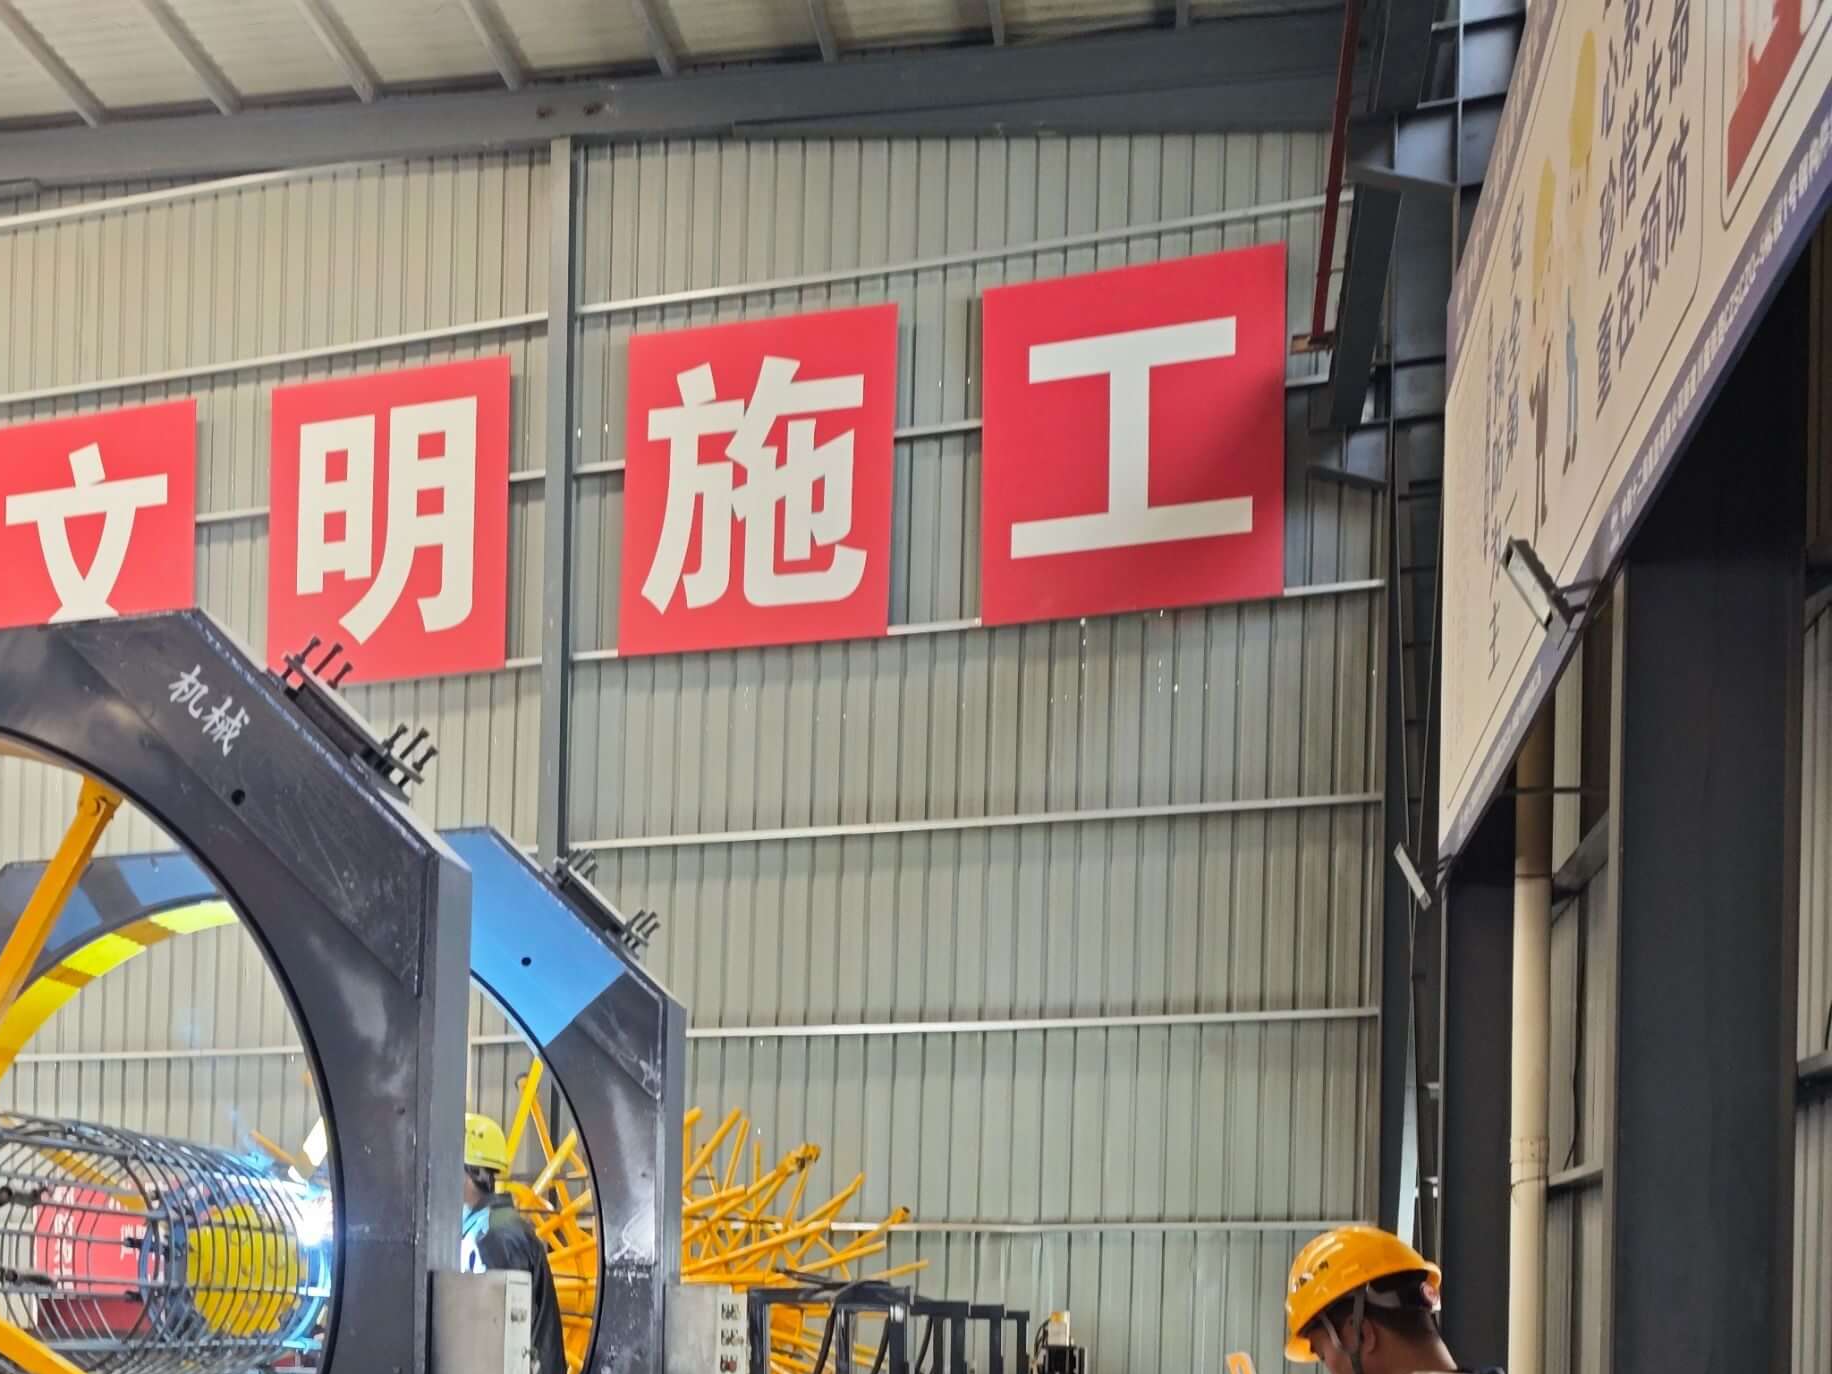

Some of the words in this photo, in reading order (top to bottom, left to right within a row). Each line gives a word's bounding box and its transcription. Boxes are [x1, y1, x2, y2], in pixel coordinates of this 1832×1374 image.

[1595, 112, 1689, 422] 重在预防
[1599, 0, 1689, 280] 珍惜生命
[5, 315, 1255, 647] 文明施工
[169, 664, 250, 757] 机械
